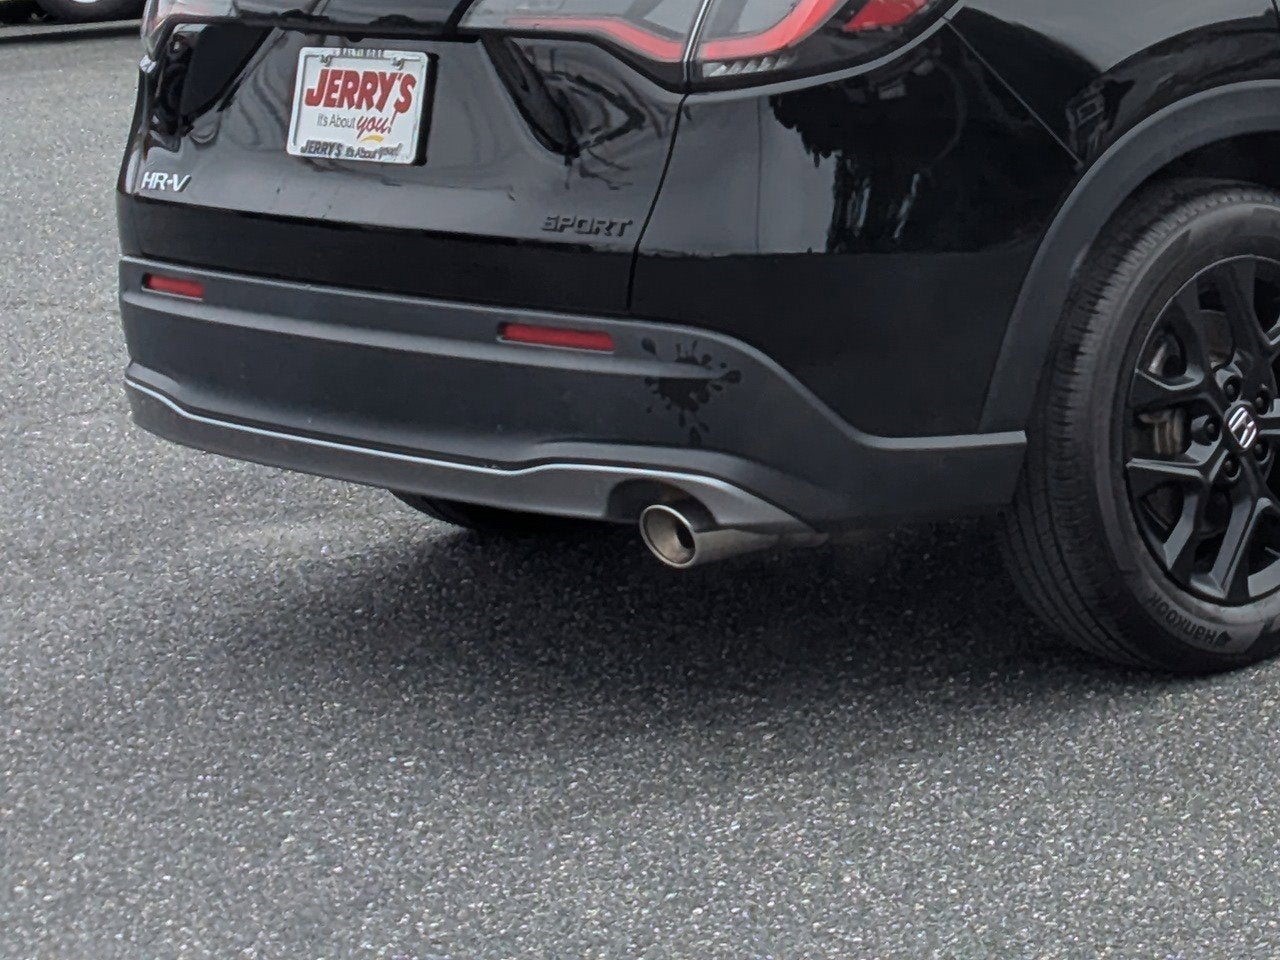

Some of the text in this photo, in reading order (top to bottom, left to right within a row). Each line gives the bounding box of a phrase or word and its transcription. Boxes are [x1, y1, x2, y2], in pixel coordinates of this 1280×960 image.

[305, 68, 417, 113] JERRY'S
[317, 111, 397, 139] It's About you!
[141, 171, 191, 192] HR-V
[541, 215, 633, 237] SPORT
